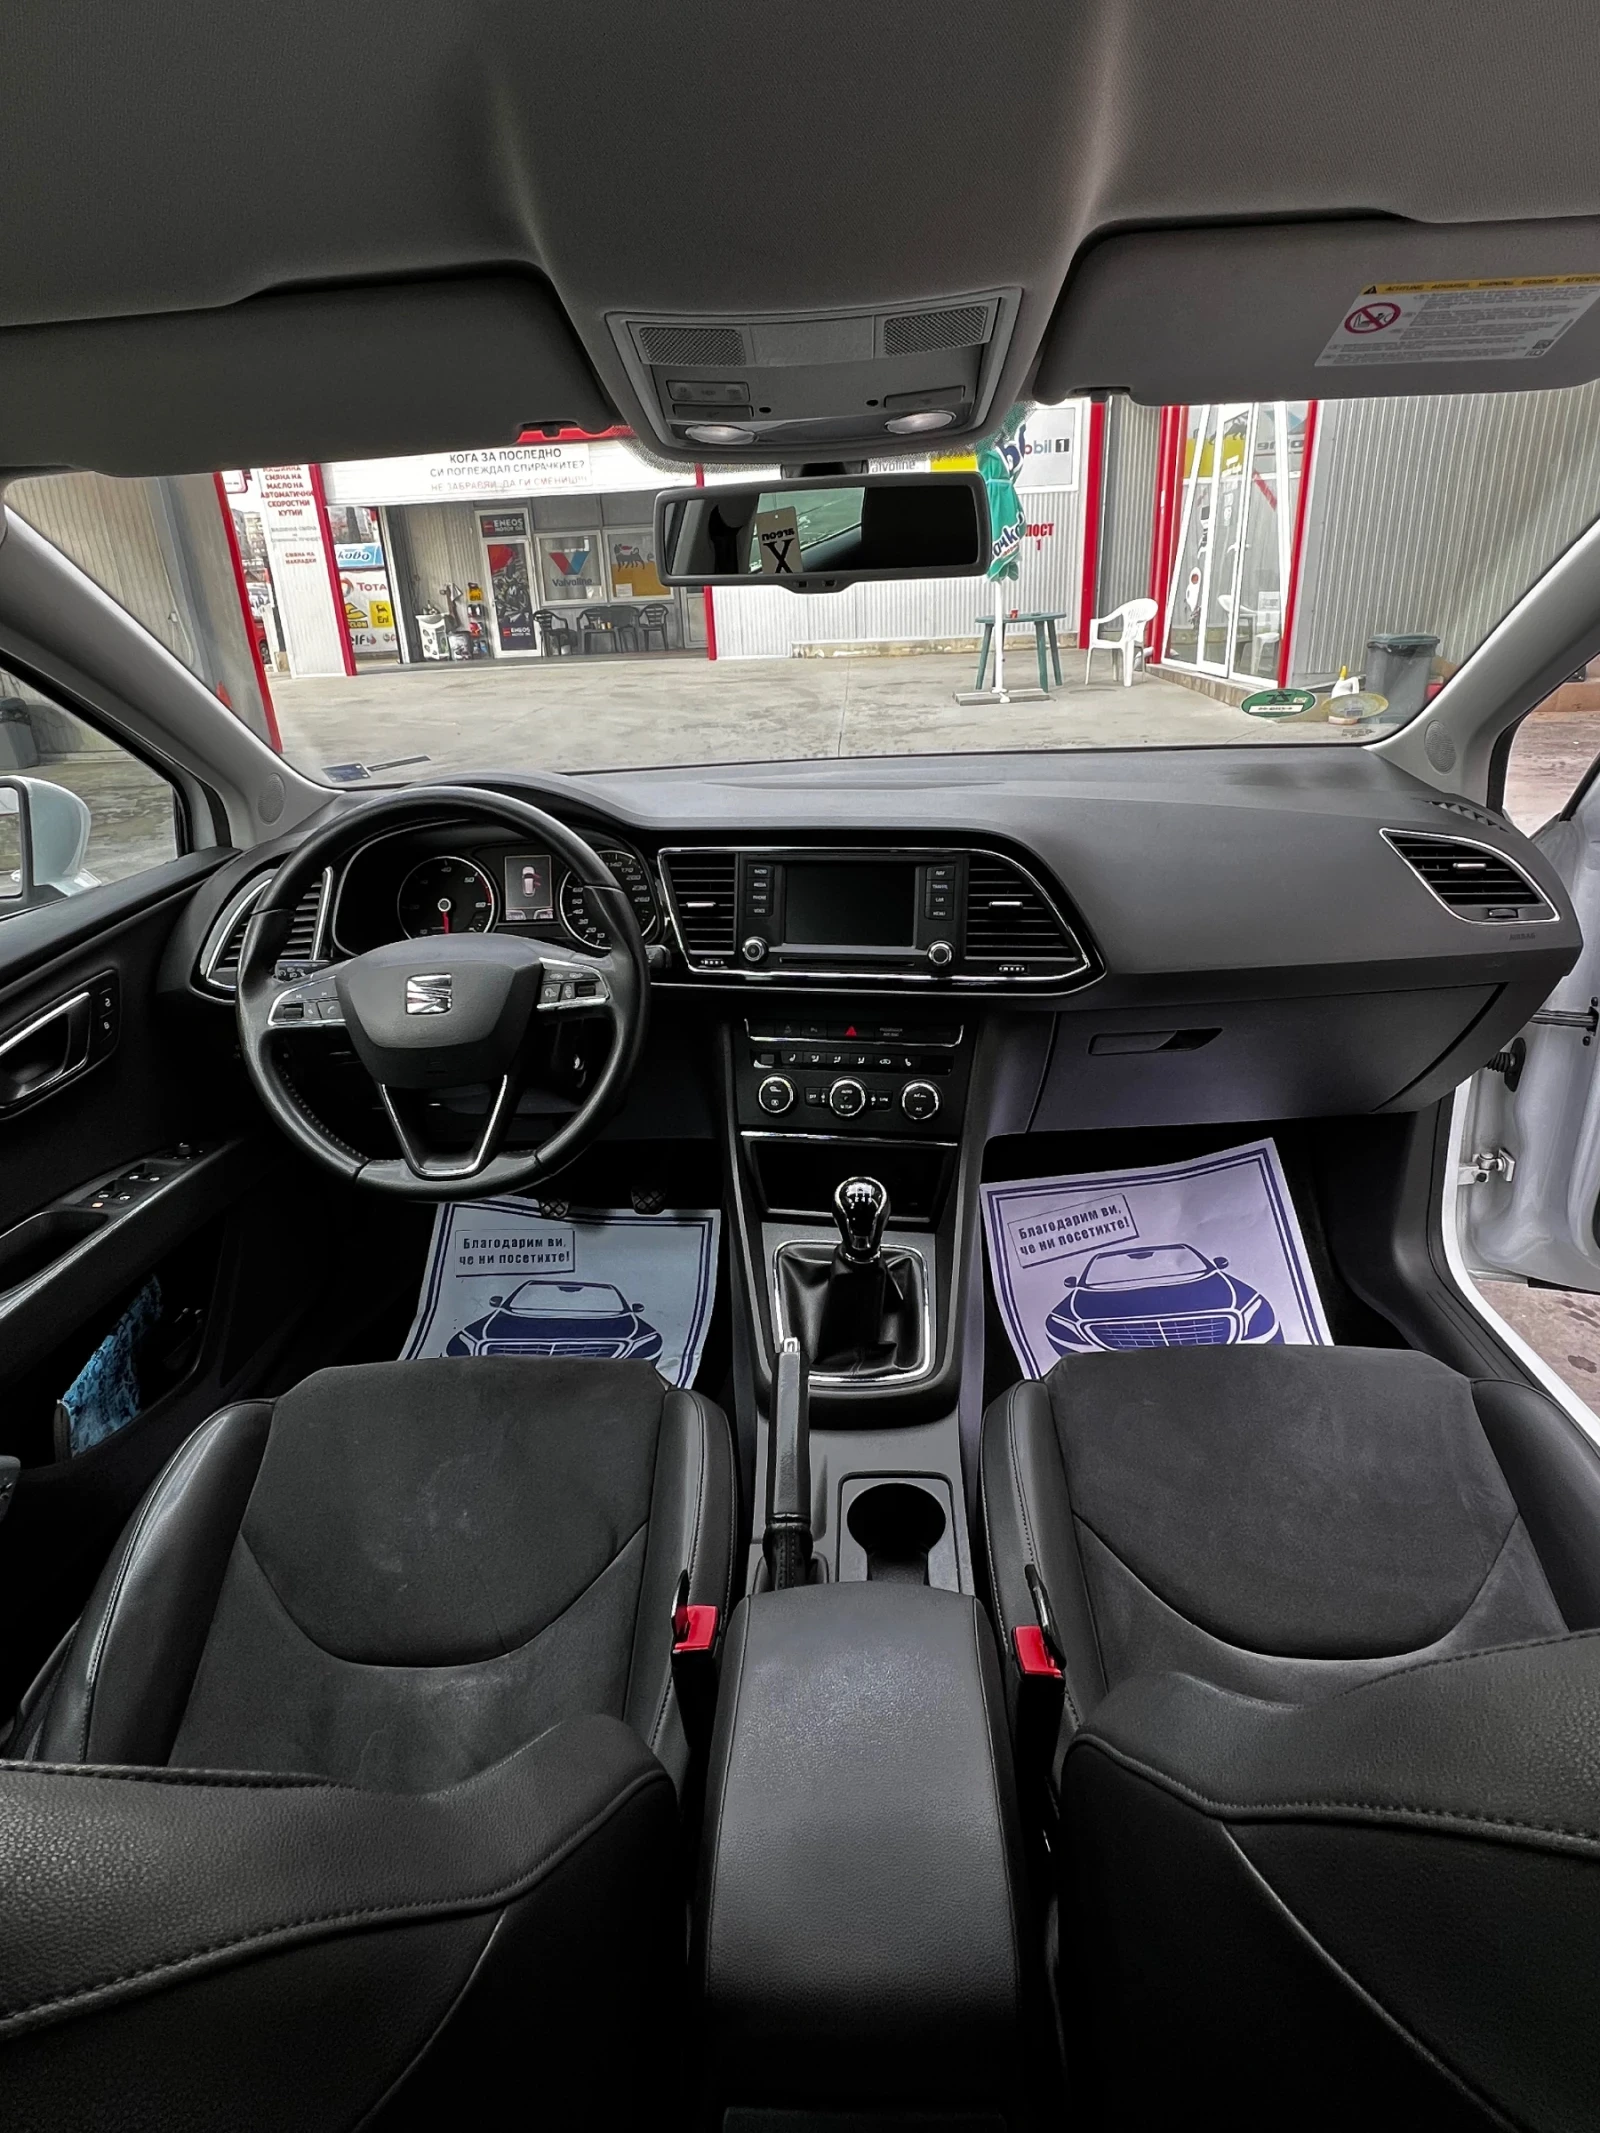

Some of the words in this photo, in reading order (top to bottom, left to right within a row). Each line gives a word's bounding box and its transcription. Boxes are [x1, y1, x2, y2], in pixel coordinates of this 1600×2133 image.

[1024, 438, 1052, 455] obil
[450, 453, 479, 464] КОГА
[481, 452, 497, 463] ЗА
[499, 447, 562, 461] ПОСЛЕДНО
[430, 468, 445, 478] СИ
[447, 464, 511, 476] ПОГЛЕЖДАЛ
[513, 460, 585, 473] СПИРАЧКИТЕ?
[493, 517, 523, 527] ENEOS
[1025, 523, 1054, 537] ПОСТ
[1036, 541, 1042, 550] 1
[357, 582, 388, 591] TOTA
[552, 578, 593, 587] Valvoline
[1018, 1209, 1099, 1240] Благодарим
[1100, 1204, 1121, 1218] ви,
[1020, 1243, 1036, 1256] че
[1038, 1238, 1056, 1252] ни
[1057, 1216, 1131, 1246] посетихте!
[463, 1238, 543, 1250] Благодарим
[547, 1238, 567, 1248] ви,
[459, 1255, 474, 1265] че
[478, 1255, 495, 1265] ни
[499, 1251, 570, 1264] посетихте!
